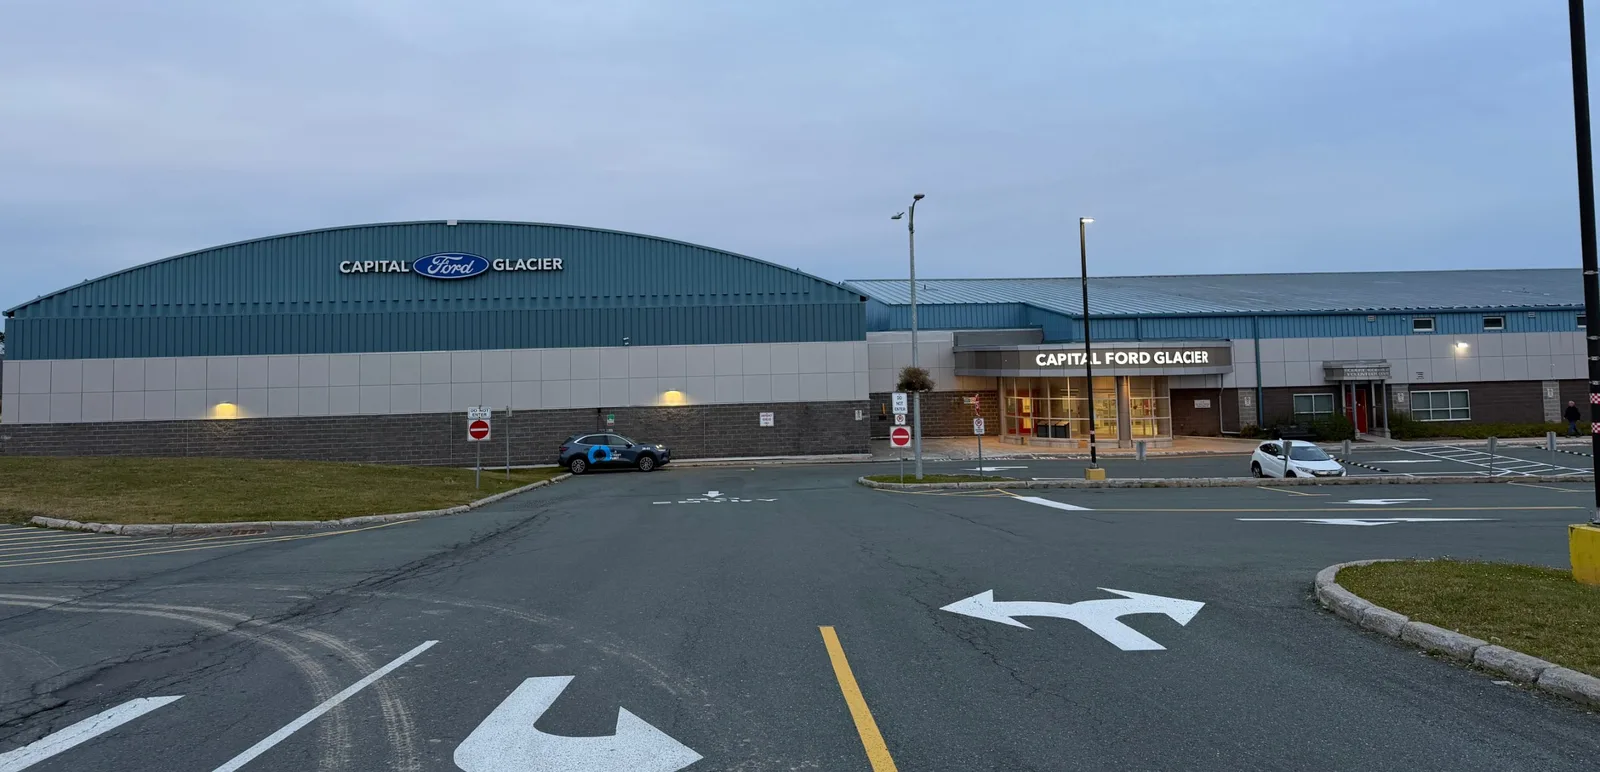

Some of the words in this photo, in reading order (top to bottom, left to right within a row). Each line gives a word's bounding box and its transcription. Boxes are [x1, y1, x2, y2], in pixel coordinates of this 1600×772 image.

[339, 260, 410, 274] CAPITAL
[426, 254, 475, 275] Ford
[492, 258, 563, 271] GLACIER
[1035, 352, 1102, 367] CAPITAL
[1105, 351, 1151, 365] FORD
[1153, 350, 1209, 365] GLACIER
